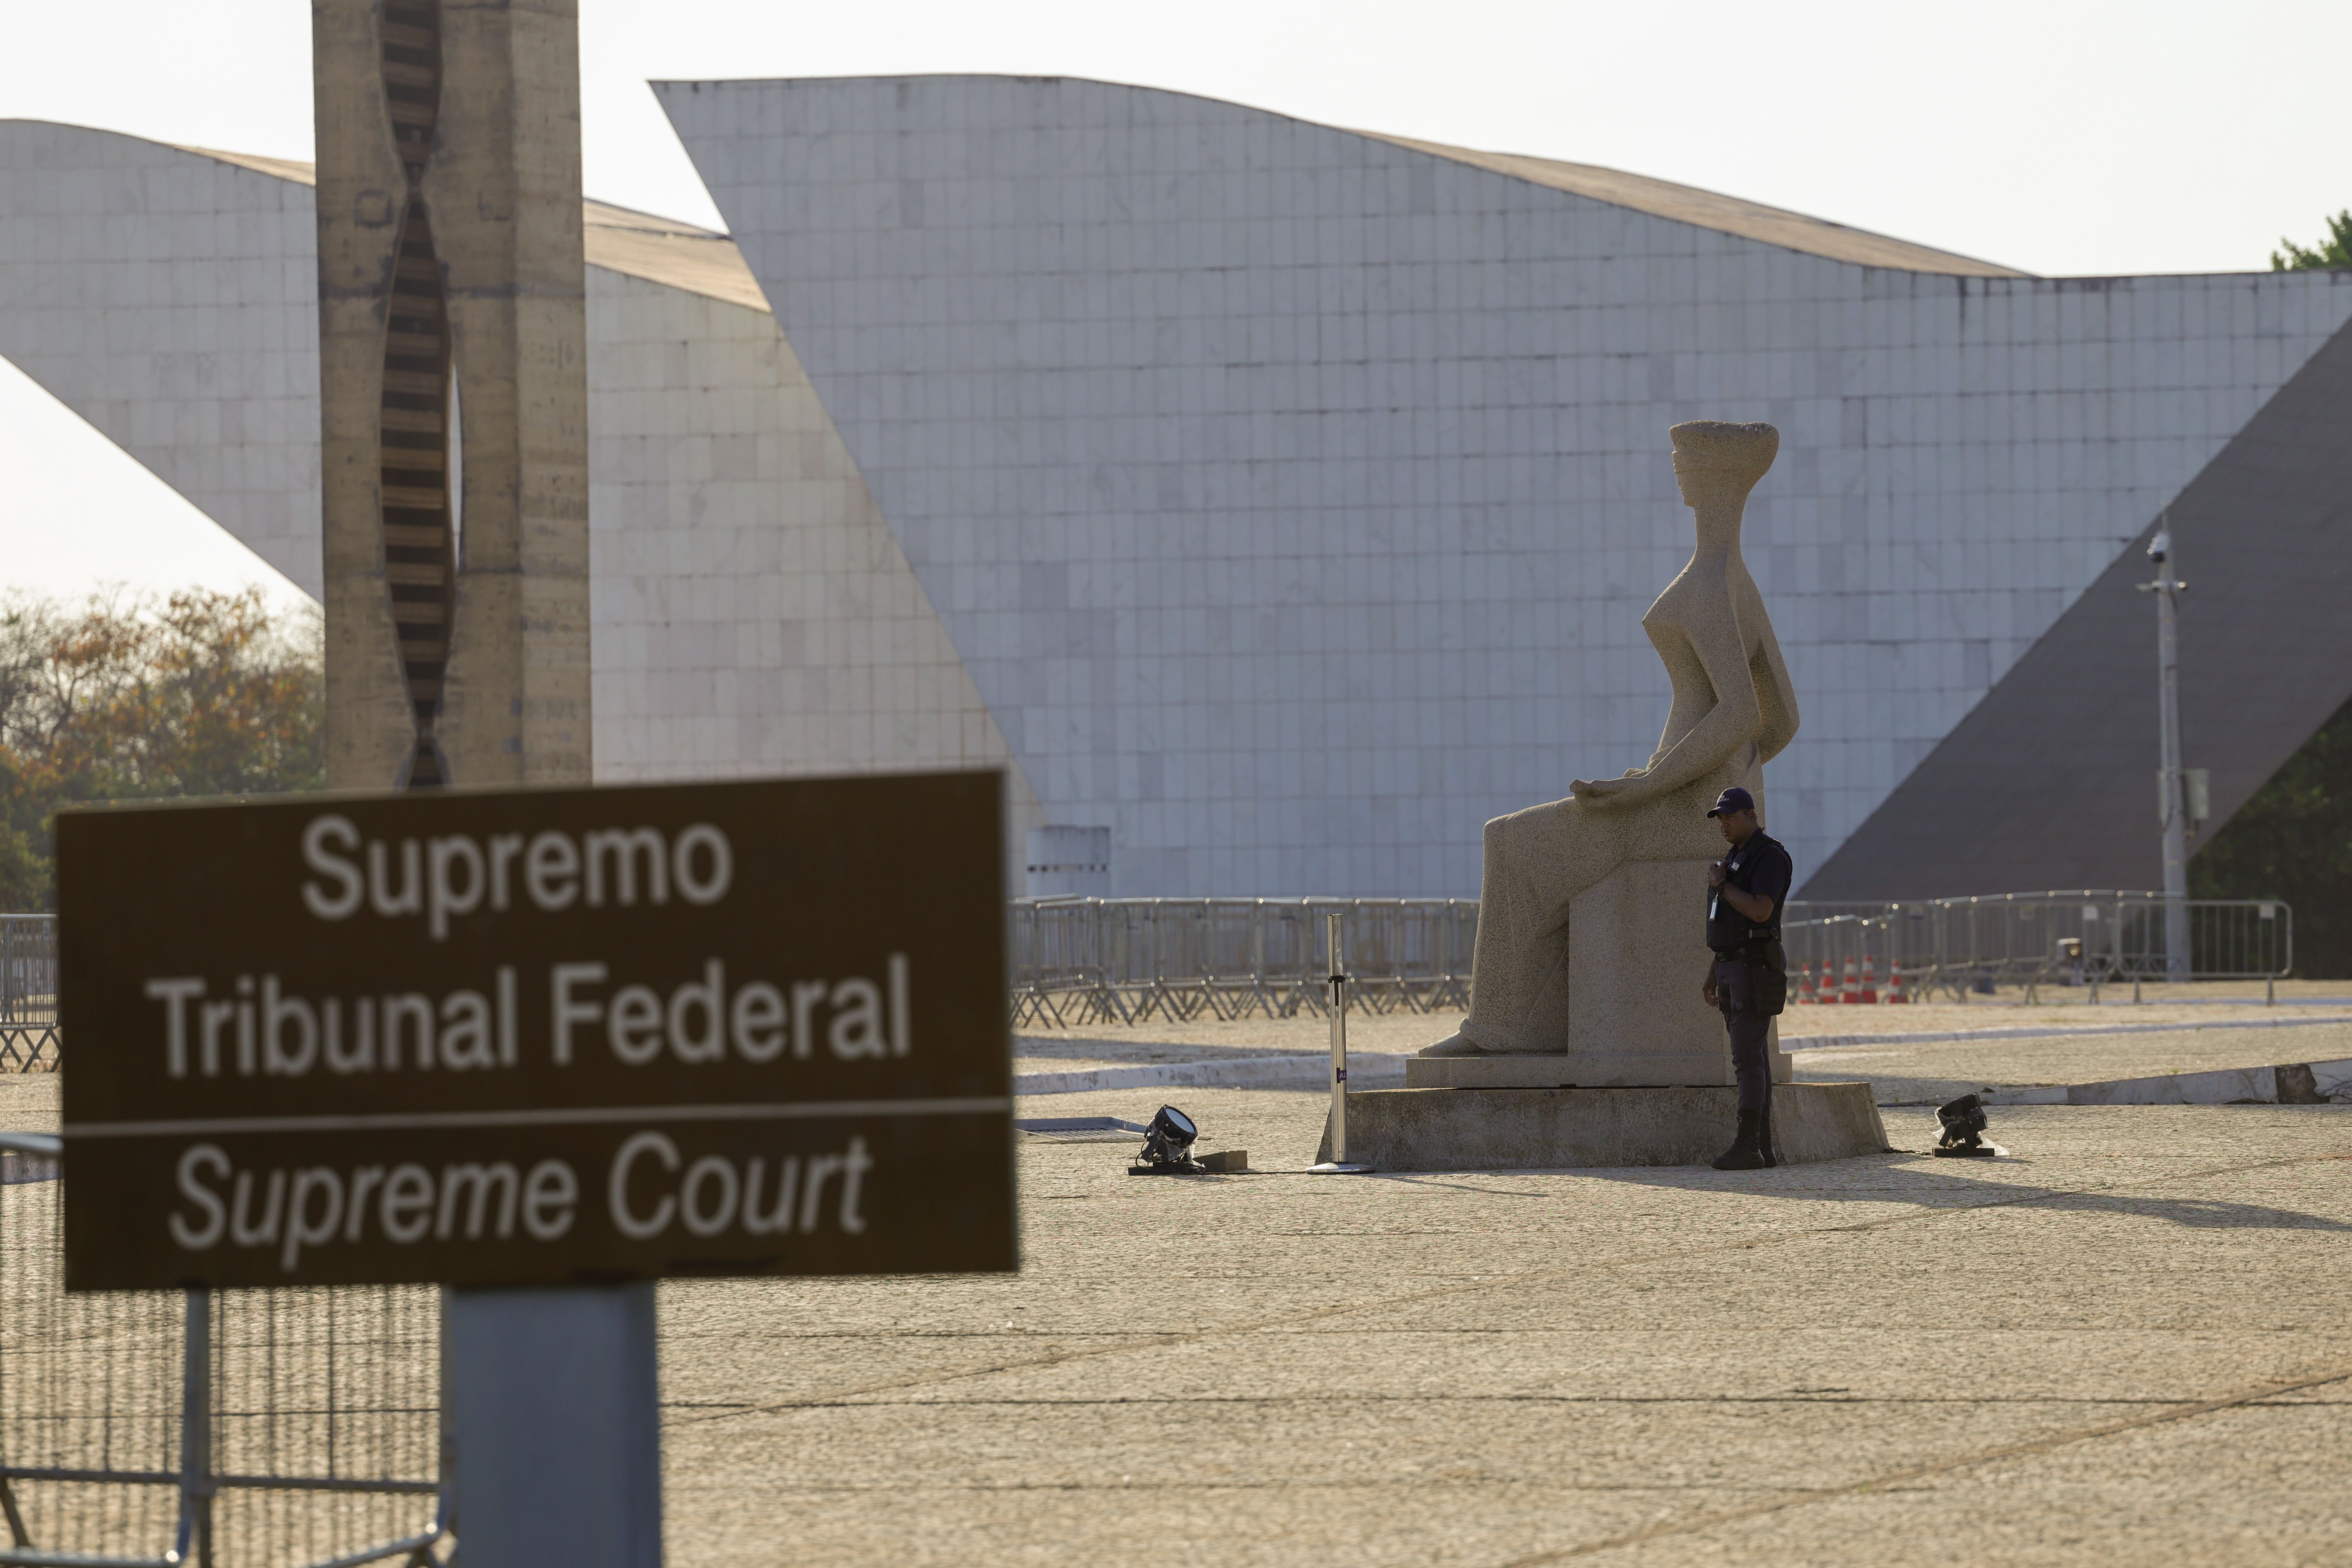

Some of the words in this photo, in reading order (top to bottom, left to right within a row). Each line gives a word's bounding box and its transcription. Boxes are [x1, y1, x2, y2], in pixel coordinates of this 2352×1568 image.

[303, 815, 732, 939] Supremo
[146, 966, 517, 1077] Tribunal
[552, 954, 910, 1064] Federal
[171, 1145, 577, 1269] Supreme
[610, 1132, 871, 1237] Court
